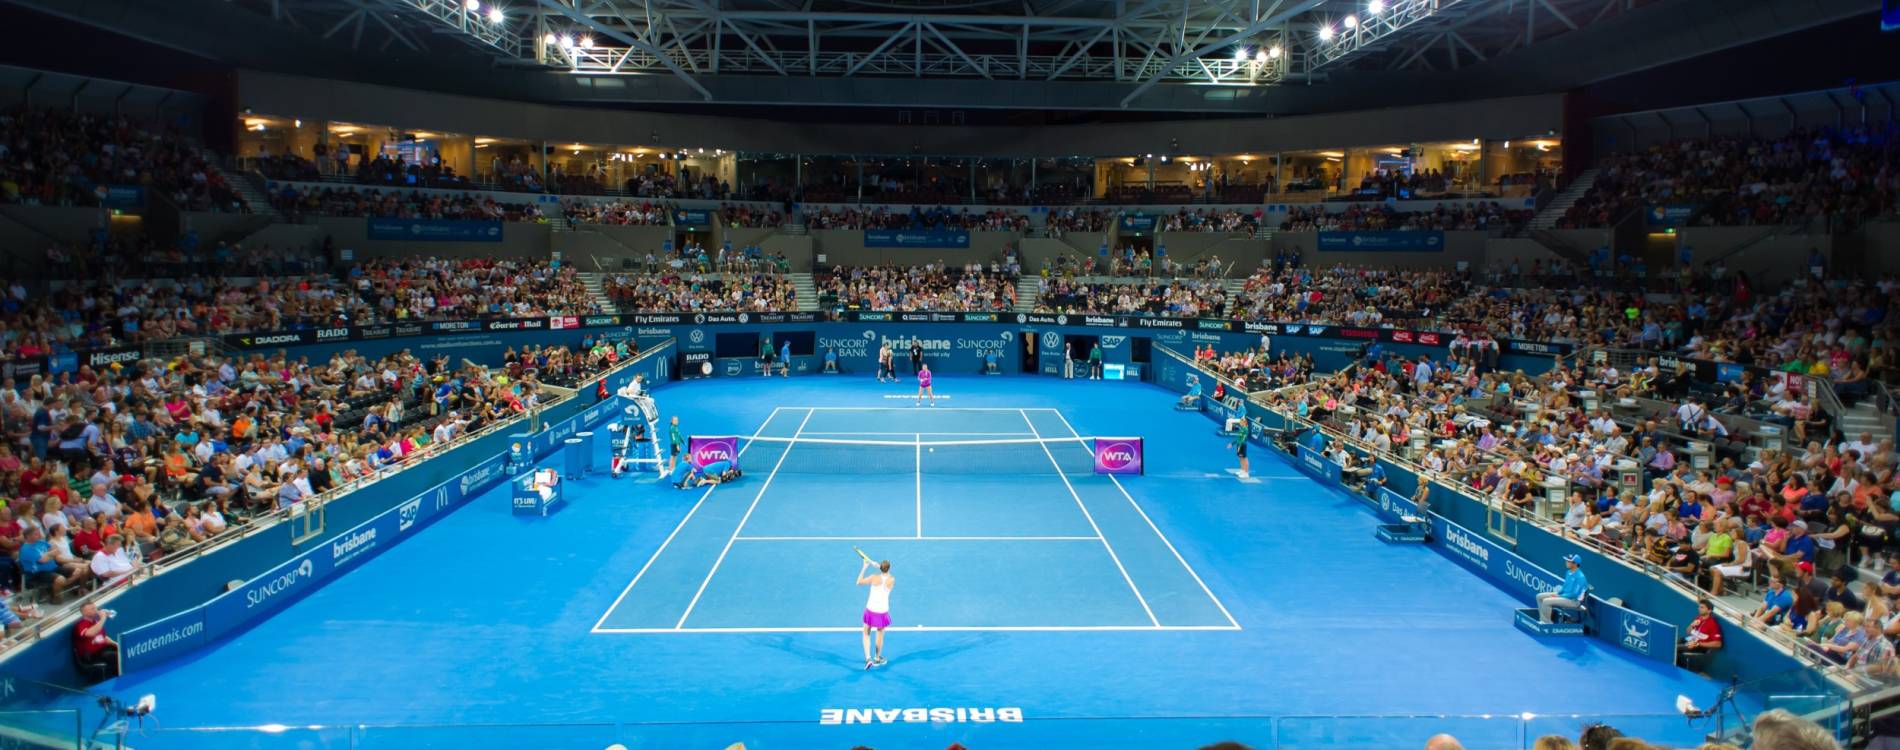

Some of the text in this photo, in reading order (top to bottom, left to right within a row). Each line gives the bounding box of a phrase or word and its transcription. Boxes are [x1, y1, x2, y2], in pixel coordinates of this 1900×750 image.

[1139, 319, 1182, 327] Fly Emirates
[1245, 322, 1278, 331] brisbane
[317, 328, 348, 337] RADO
[638, 327, 671, 335] brisbane
[1309, 327, 1323, 335] SAP
[255, 335, 300, 345] DIADORA
[1103, 337, 1121, 345] SAP
[1192, 332, 1221, 341] brisbane
[819, 338, 868, 348] SUNCORP
[956, 338, 1006, 349] SUNCORP
[90, 351, 140, 366] Hisense
[838, 349, 867, 358] BANK
[1659, 356, 1697, 371] brisbne
[700, 451, 729, 459] WTA
[1104, 452, 1132, 461] WTA
[400, 507, 418, 527] SAP
[333, 527, 377, 559] brisbane
[1446, 525, 1489, 561] brisbane
[1505, 560, 1553, 594] SUNCORP
[247, 568, 299, 608] SUNCORP
[1635, 616, 1650, 626] 250
[126, 620, 203, 659] wtatennis.com
[1623, 636, 1648, 649] ATP
[820, 707, 1024, 725] BRISBANE
